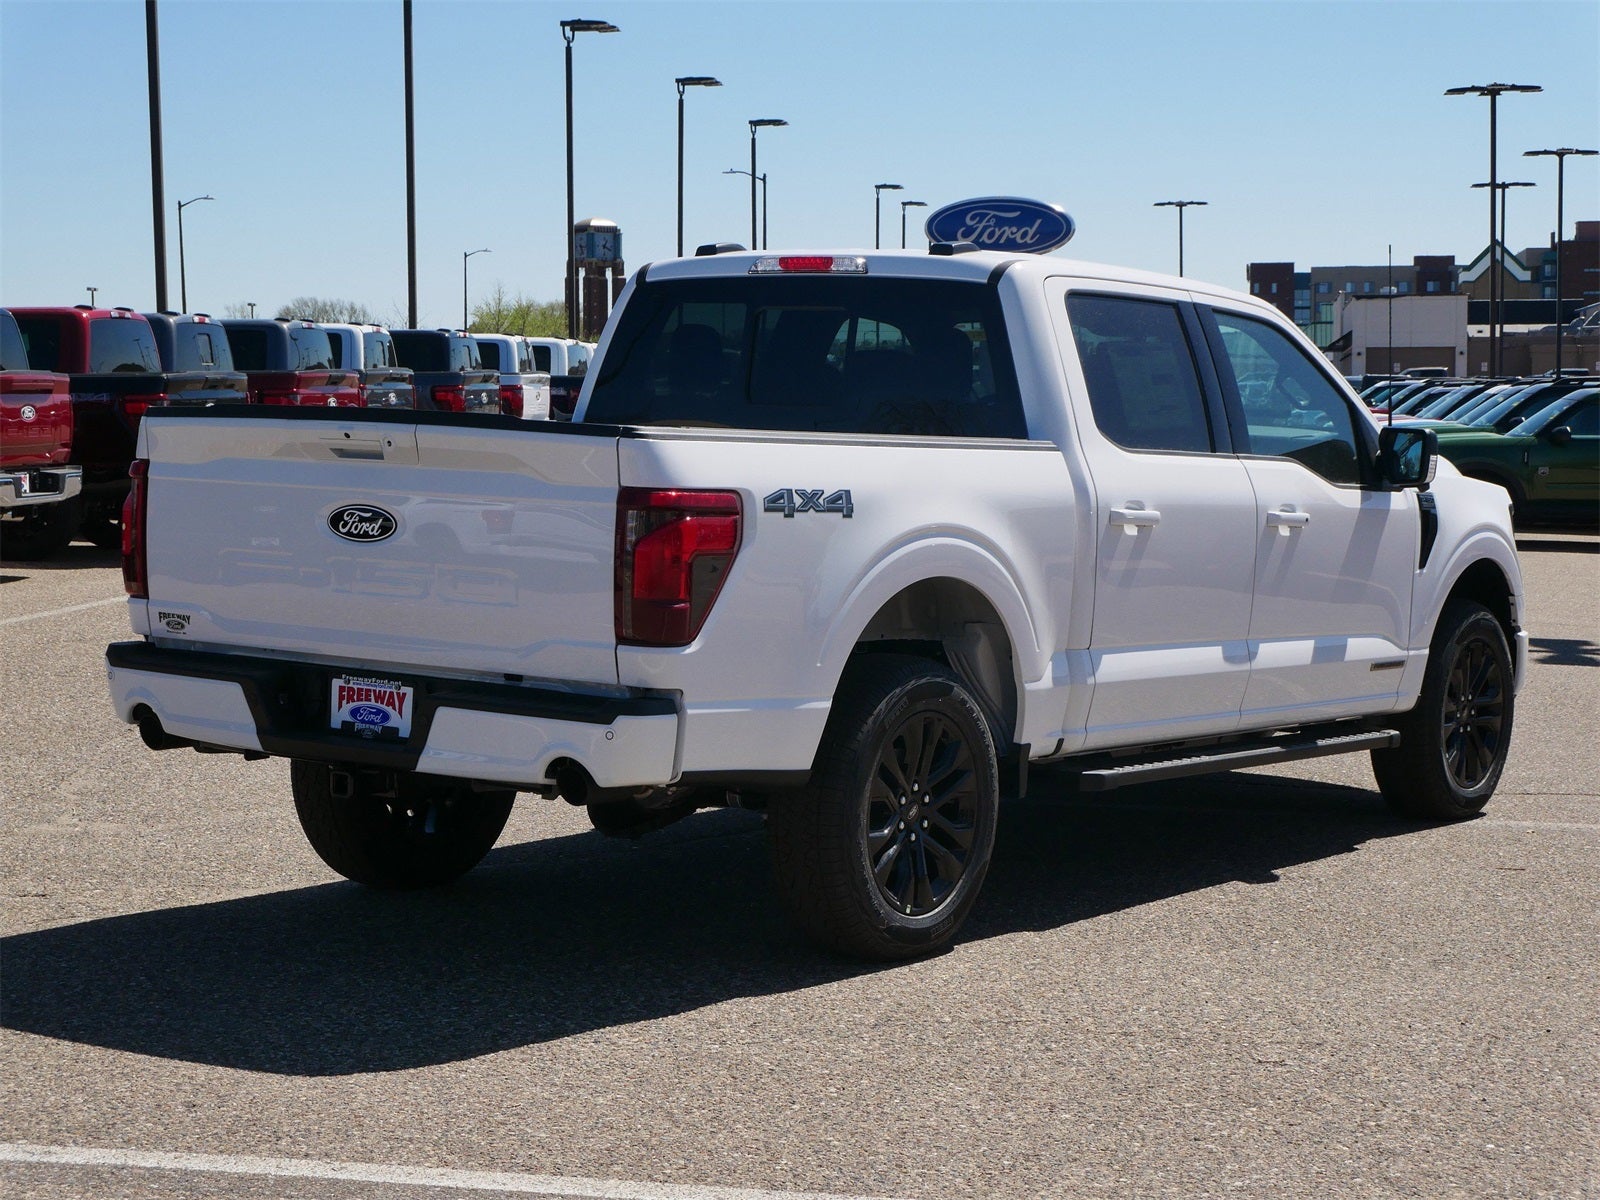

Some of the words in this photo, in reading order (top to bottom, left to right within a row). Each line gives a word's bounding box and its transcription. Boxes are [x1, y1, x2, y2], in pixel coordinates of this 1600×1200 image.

[957, 209, 1042, 243] Ford
[339, 510, 383, 535] Ford
[158, 612, 190, 625] FREEWAY
[342, 674, 402, 686] FreewayFord.net
[338, 685, 407, 720] FREEWAY
[356, 706, 383, 723] Ford
